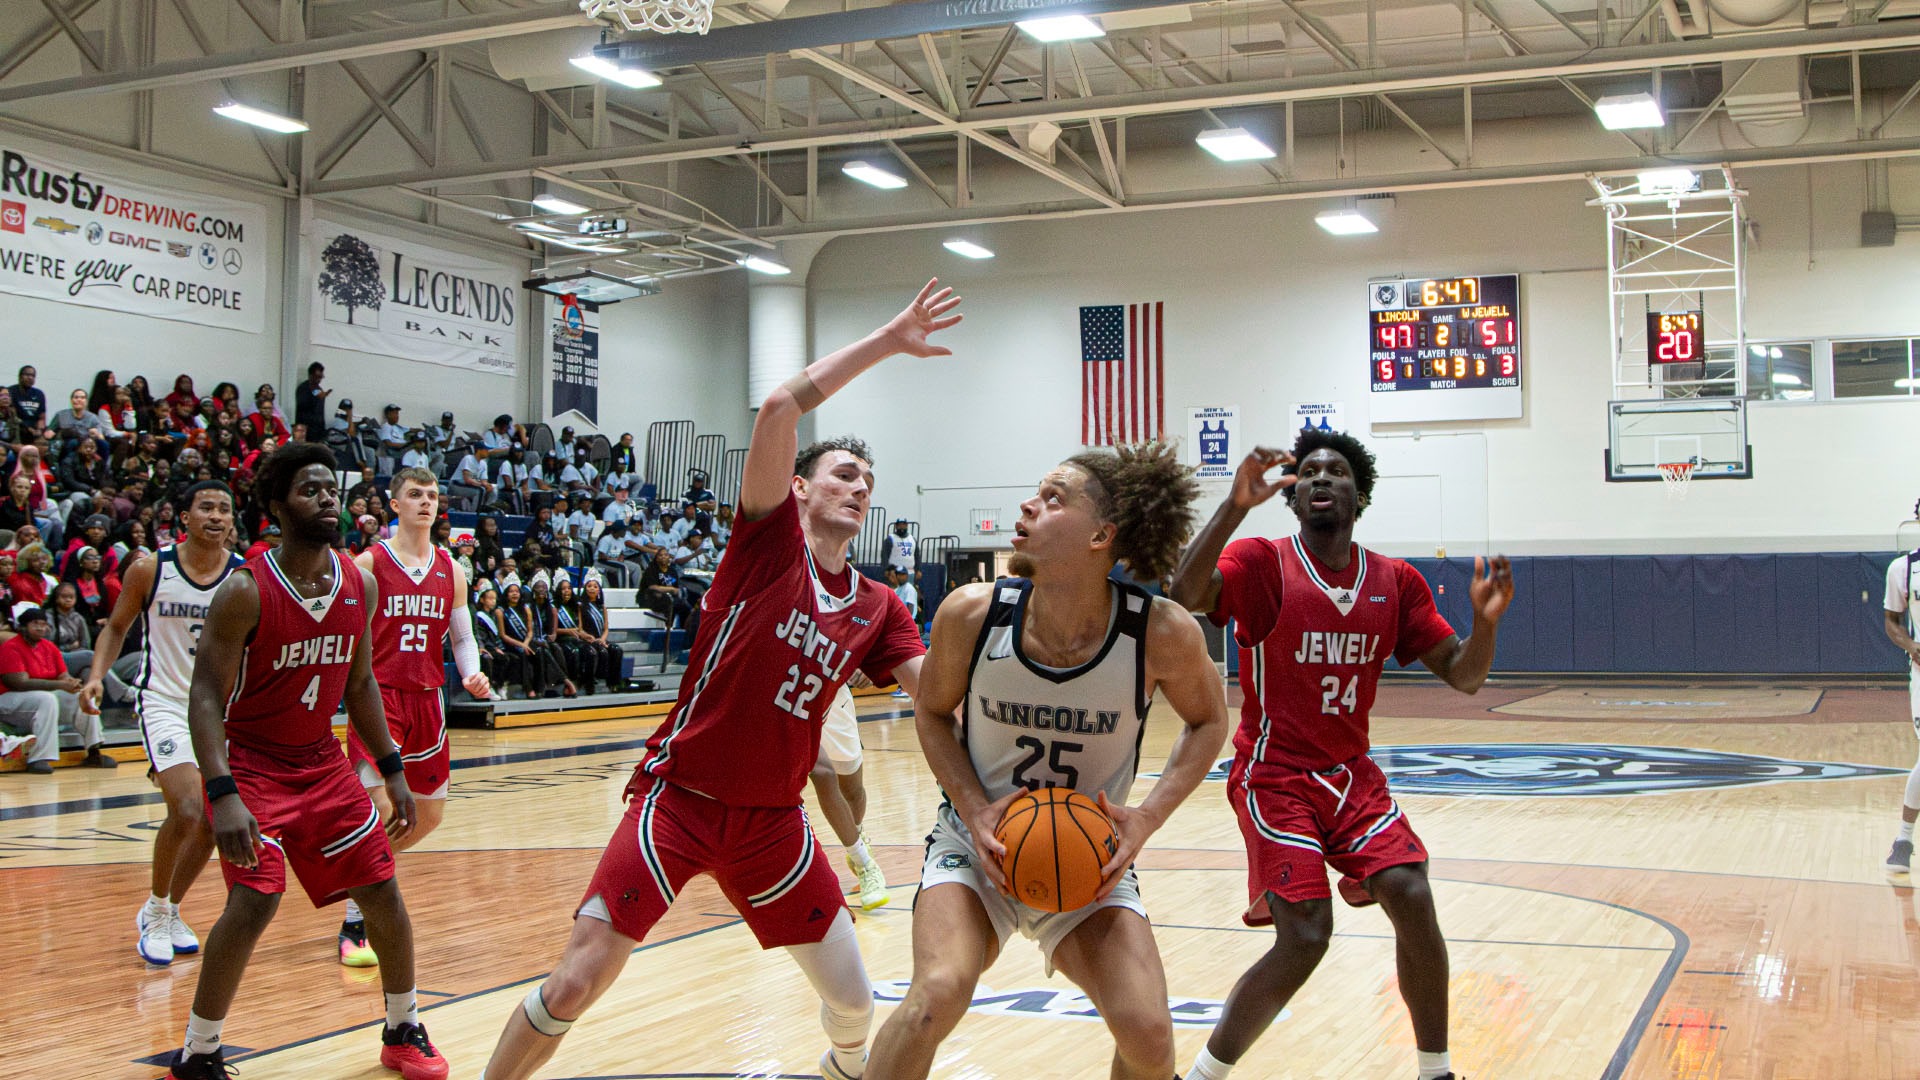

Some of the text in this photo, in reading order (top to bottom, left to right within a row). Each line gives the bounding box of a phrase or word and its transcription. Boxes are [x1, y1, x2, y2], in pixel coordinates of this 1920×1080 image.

[109, 231, 162, 252] GMC
[0, 248, 241, 310] WE'RE your CAR PEOPLE
[391, 252, 514, 326] LEGENDS
[1423, 279, 1476, 306] 6:47
[1379, 310, 1420, 323] LINCOLN
[1432, 315, 1454, 323] GAME
[1472, 306, 1509, 318] JEWELL
[1661, 314, 1697, 331] 6:47
[405, 320, 502, 347] BANK
[1381, 325, 1412, 348] 47
[1436, 325, 1449, 346] 2
[1418, 350, 1446, 358] PLAYER
[1492, 347, 1516, 355] FOULS
[1659, 332, 1692, 359] 20
[1372, 352, 1396, 360] FOULS
[1502, 354, 1514, 376] 3
[1380, 361, 1394, 380] 5
[1406, 364, 1413, 378] 1
[1433, 359, 1447, 377] 4
[1454, 357, 1466, 377] 3
[1476, 360, 1485, 376] 3
[1373, 383, 1397, 391] SCORE
[1430, 380, 1457, 389] MATCH
[1492, 378, 1517, 386] SCORE
[1209, 442, 1220, 452] 24
[901, 548, 911, 556] 34
[158, 600, 210, 620] LINCO
[384, 595, 445, 620] JEWELL
[400, 624, 428, 652] 25
[1295, 632, 1380, 664] JEWELL
[273, 635, 355, 671] JEWELL
[301, 675, 320, 711] 4
[774, 664, 823, 720] 22
[1321, 675, 1358, 715] 24
[979, 695, 1121, 735] LINCOLN
[1012, 735, 1084, 792] 25
